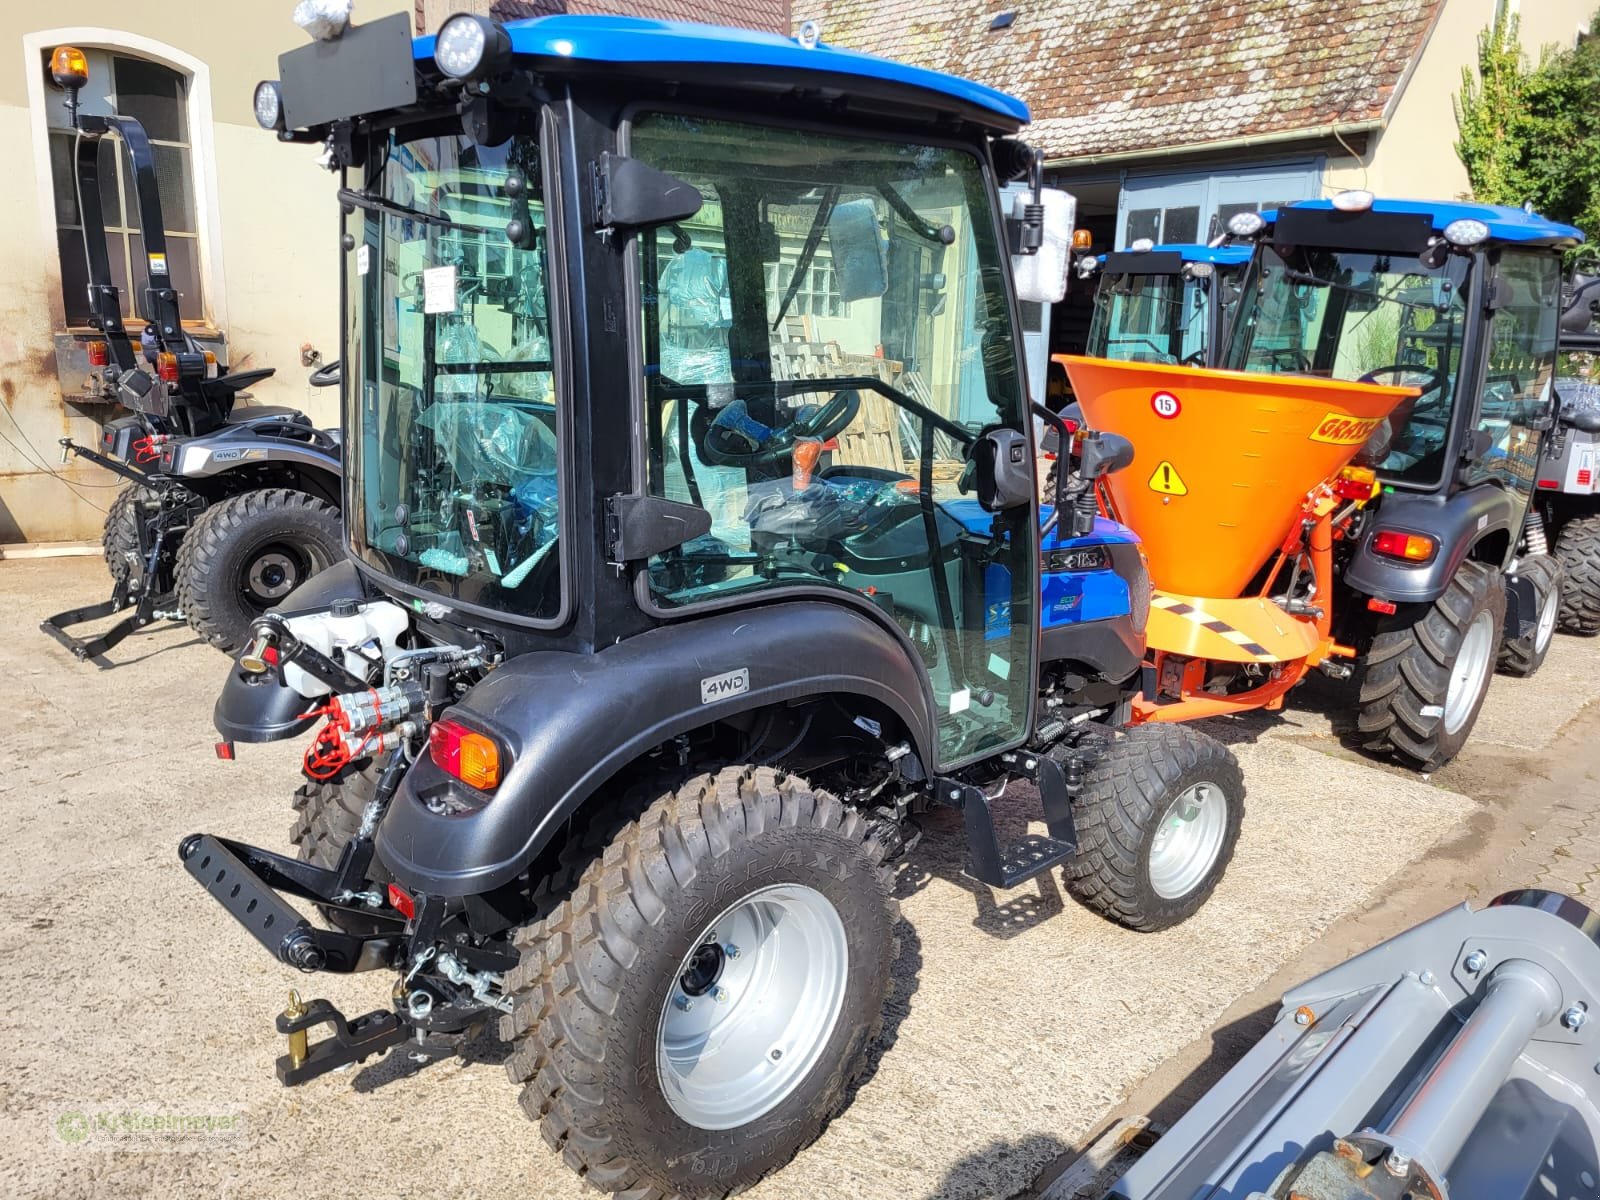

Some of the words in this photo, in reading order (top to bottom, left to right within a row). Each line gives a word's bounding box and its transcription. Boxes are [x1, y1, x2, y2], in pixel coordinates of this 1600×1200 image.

[1158, 398, 1172, 412] 15
[706, 675, 744, 695] 4WD
[682, 850, 855, 931] GALAXY
